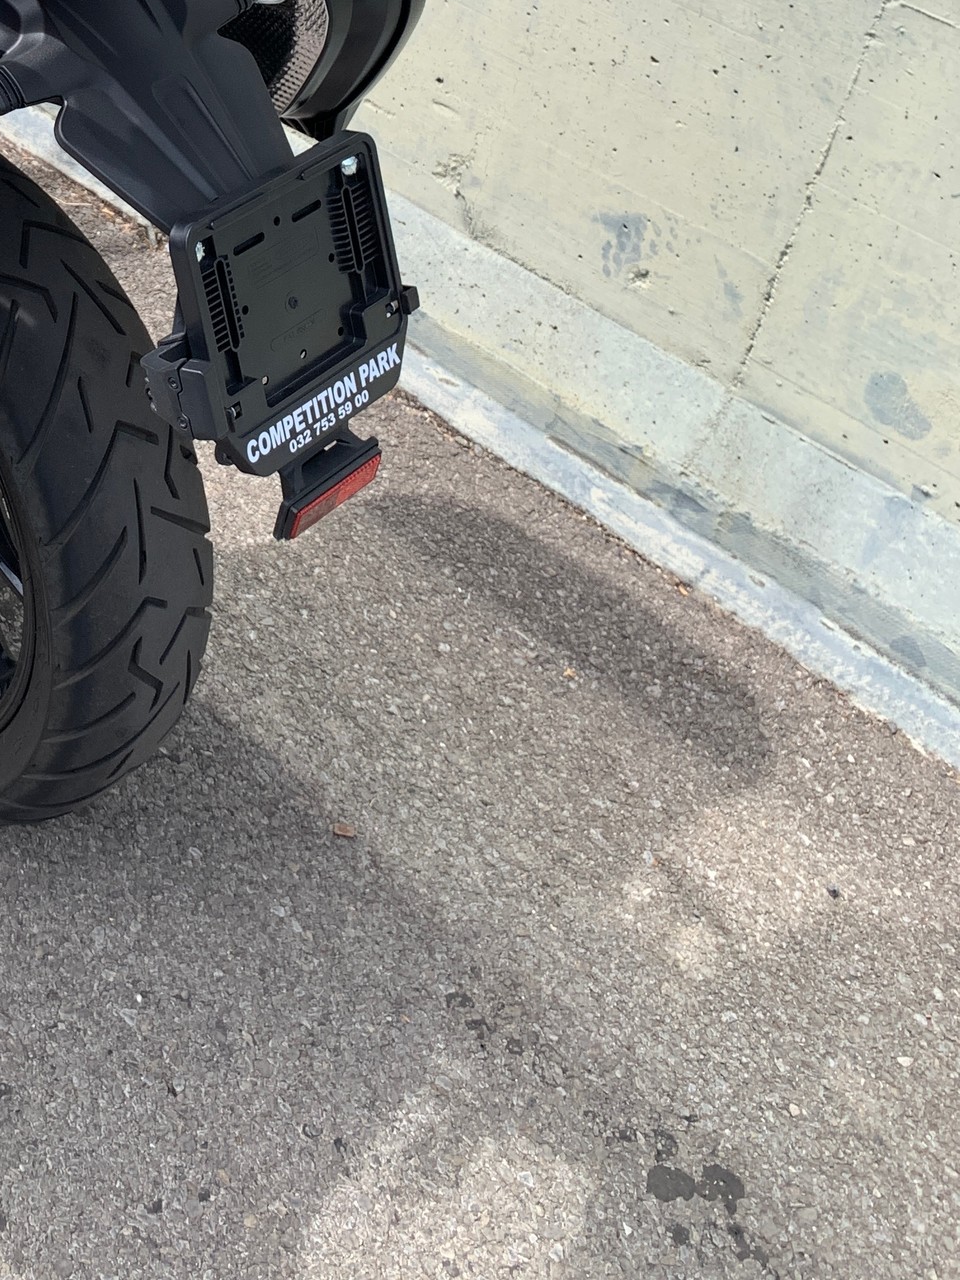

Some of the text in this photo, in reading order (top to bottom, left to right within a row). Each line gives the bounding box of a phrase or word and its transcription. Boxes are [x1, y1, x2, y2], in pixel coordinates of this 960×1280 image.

[246, 342, 401, 463] COMPETITION PARK
[289, 389, 370, 453] 032 753 59 00
